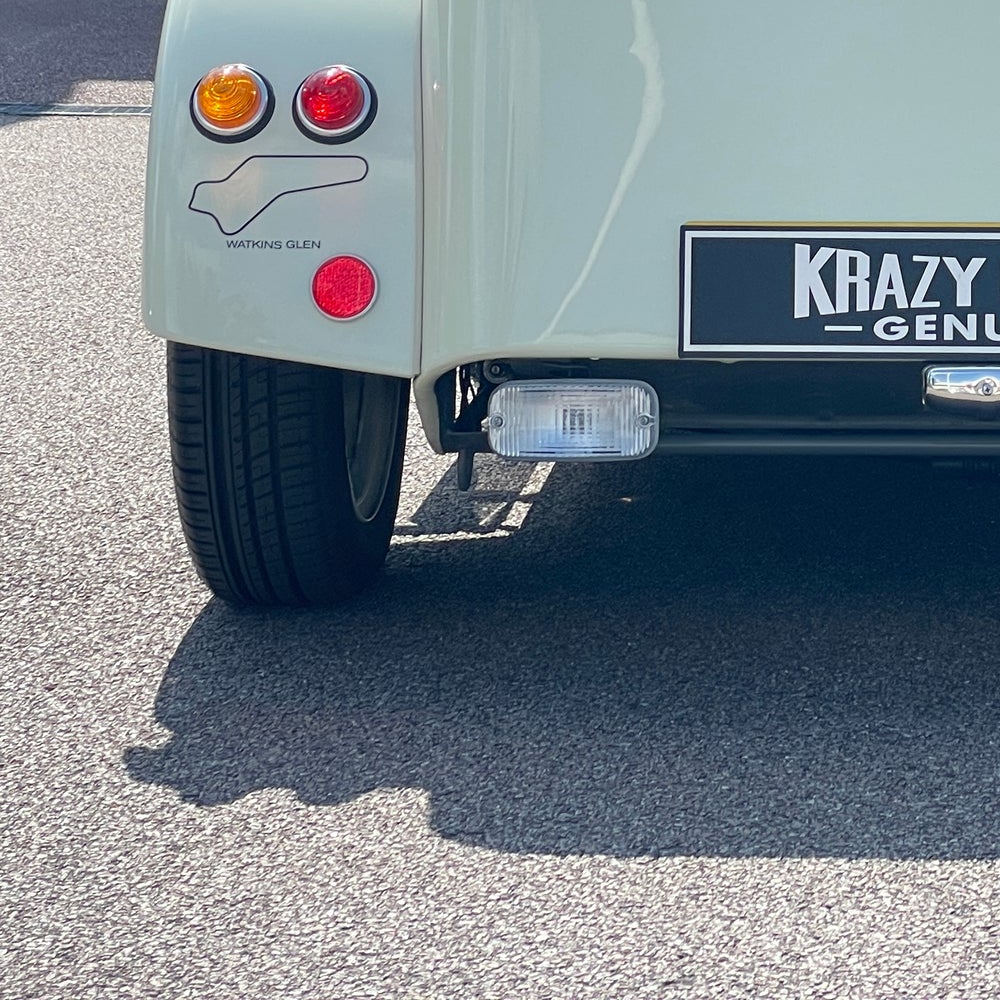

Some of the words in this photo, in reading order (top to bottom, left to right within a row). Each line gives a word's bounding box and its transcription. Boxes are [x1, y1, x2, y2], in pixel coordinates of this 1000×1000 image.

[226, 239, 283, 250] WATKINS
[285, 239, 321, 250] GLEN
[793, 243, 987, 319] KRAZY
